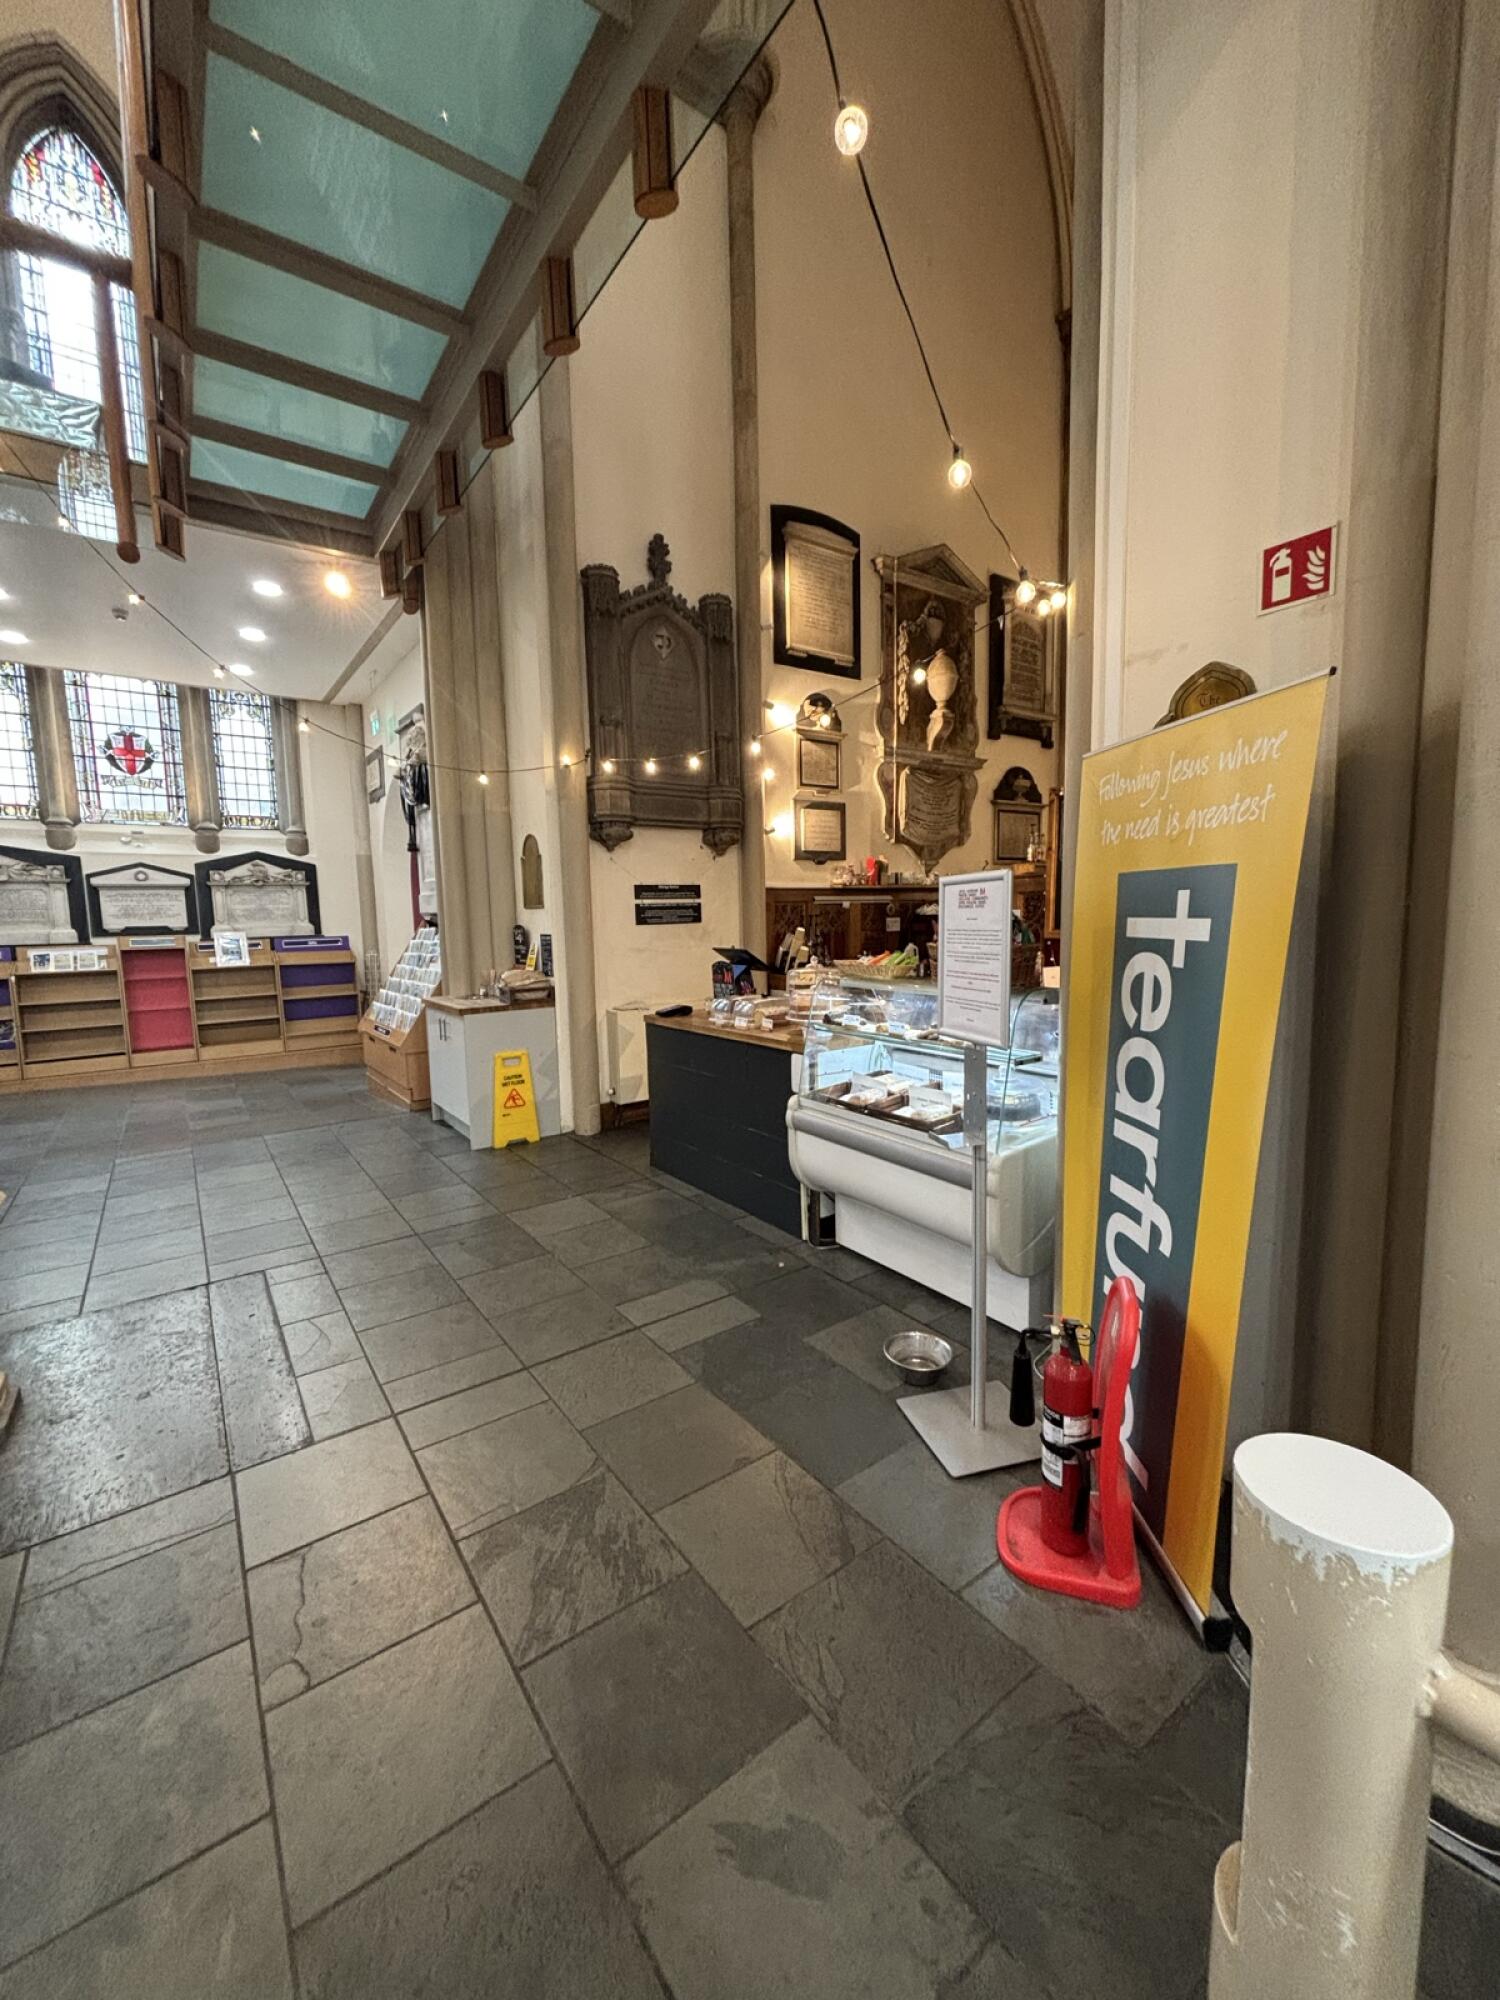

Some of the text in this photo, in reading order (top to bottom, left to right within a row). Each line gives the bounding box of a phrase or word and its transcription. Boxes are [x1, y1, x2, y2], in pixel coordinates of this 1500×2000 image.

[1099, 729, 1288, 807] Following Jesus where
[1124, 809, 1161, 839] need
[1166, 803, 1180, 839] is
[1185, 783, 1277, 846] greatest
[1104, 889, 1213, 1490] tearfu
